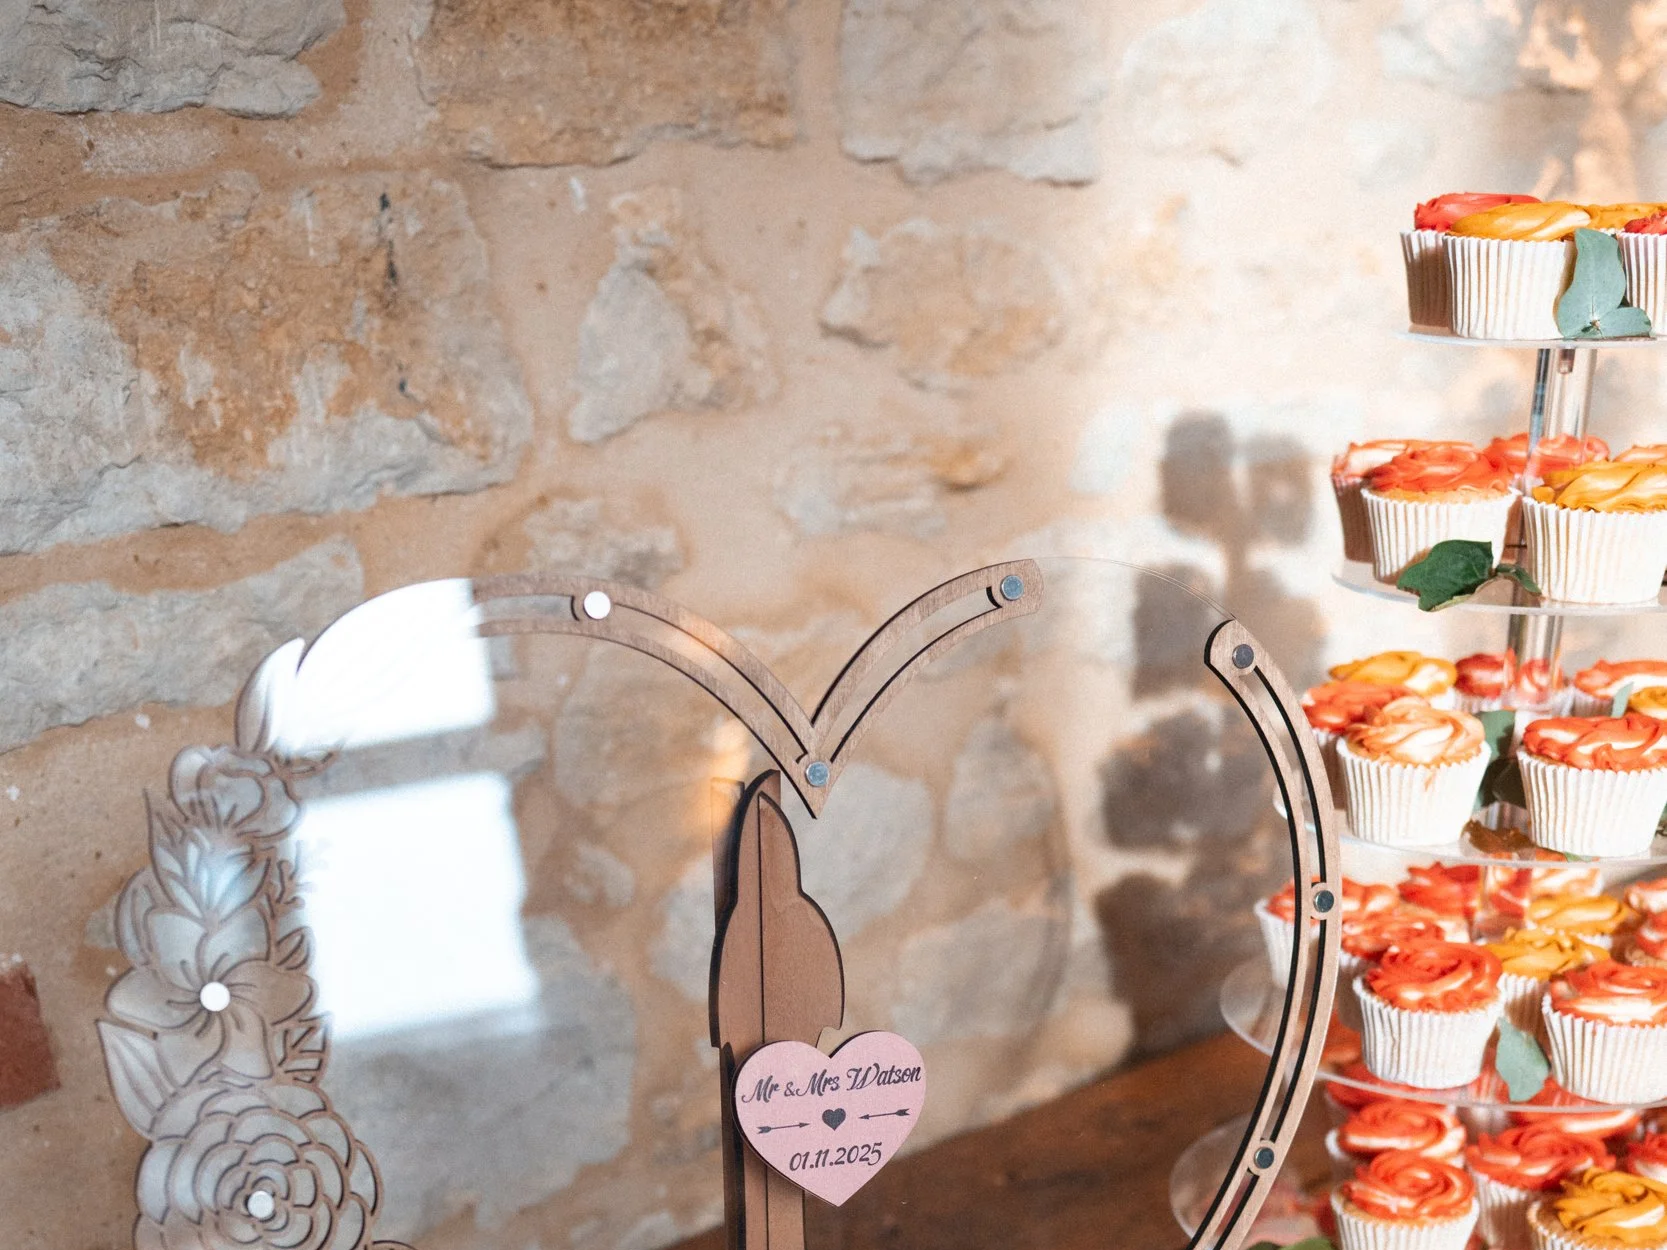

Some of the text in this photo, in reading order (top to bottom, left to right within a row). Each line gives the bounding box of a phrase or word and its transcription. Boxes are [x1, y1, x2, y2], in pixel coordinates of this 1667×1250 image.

[742, 1063, 921, 1103] Mr & Mrs Watson
[789, 1142, 882, 1171] 01.11.2025
